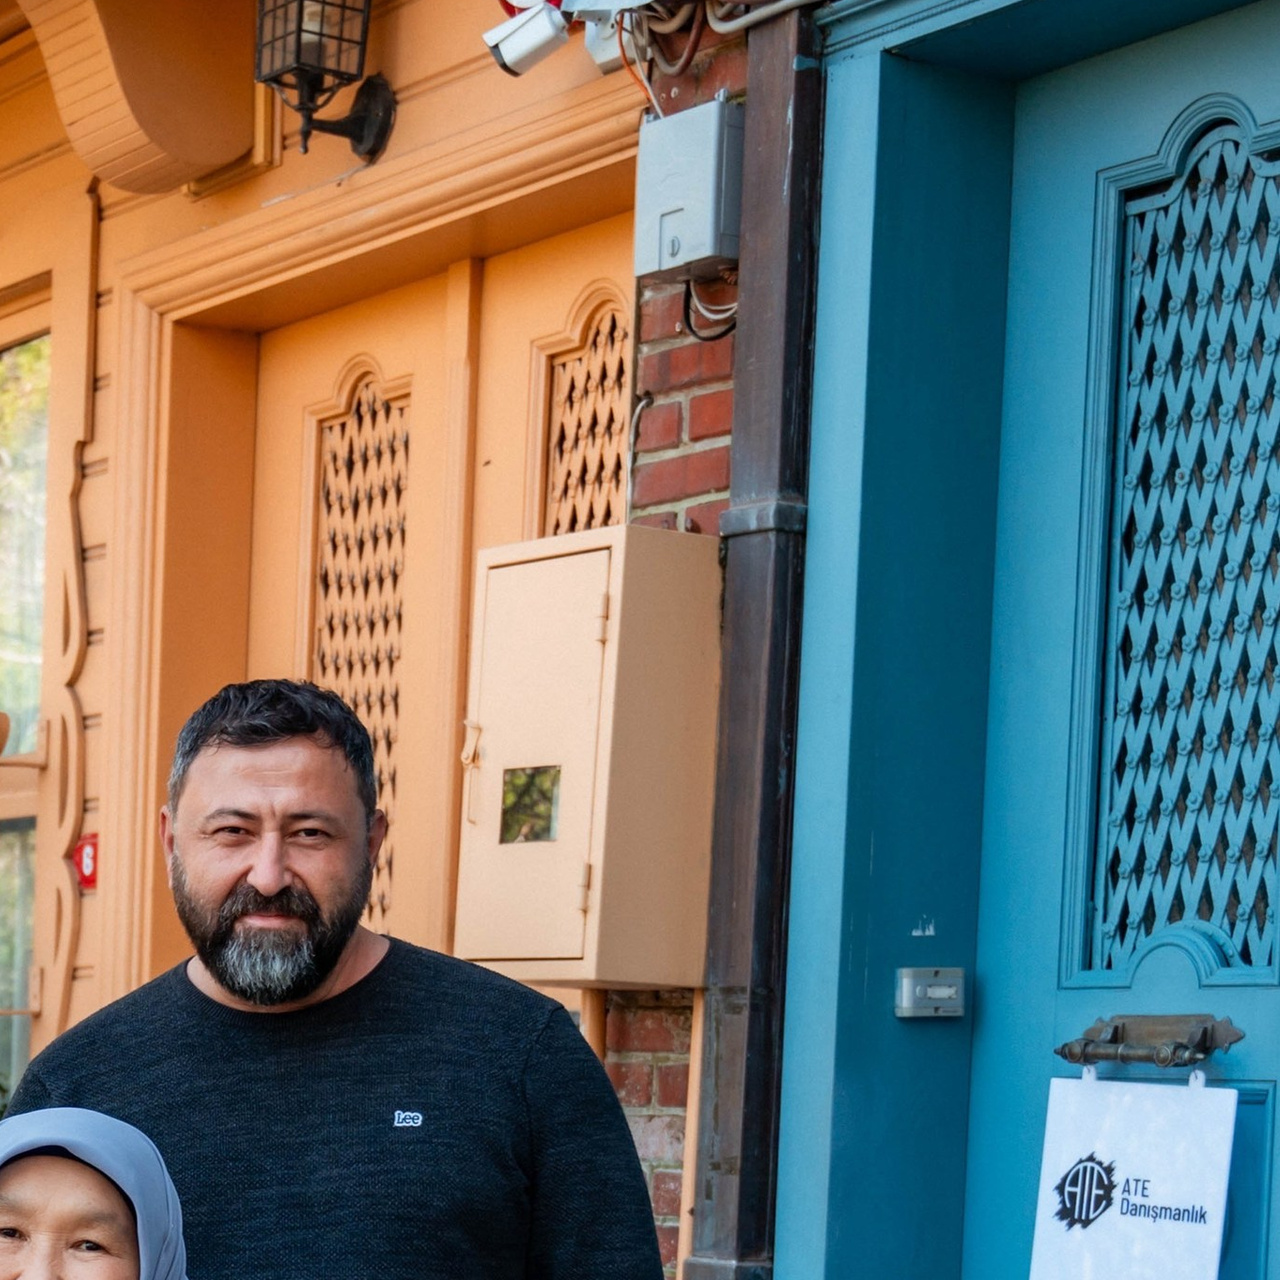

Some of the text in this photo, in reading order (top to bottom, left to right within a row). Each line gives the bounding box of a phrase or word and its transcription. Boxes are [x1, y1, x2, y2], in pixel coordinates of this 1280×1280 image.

[394, 1110, 423, 1127] Lee
[1121, 1178, 1151, 1198] ATE
[1120, 1198, 1208, 1224] Danışmanlık
